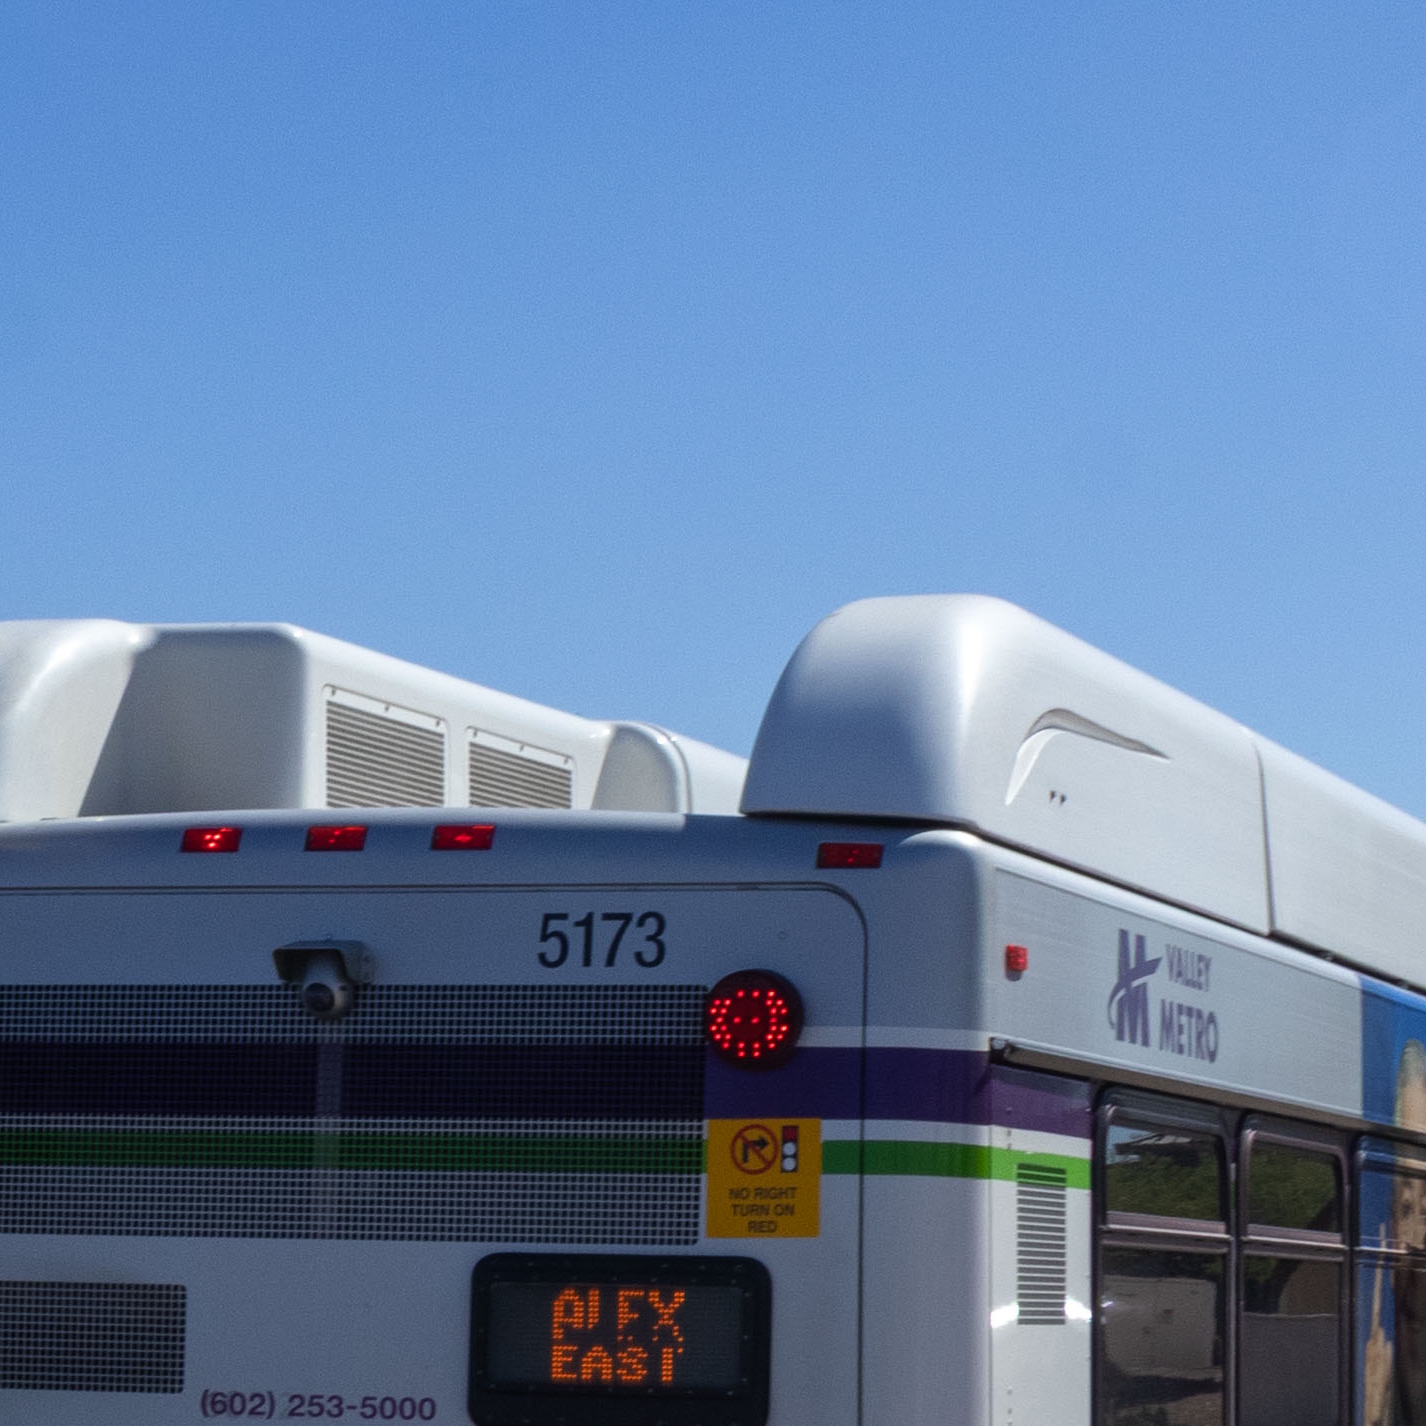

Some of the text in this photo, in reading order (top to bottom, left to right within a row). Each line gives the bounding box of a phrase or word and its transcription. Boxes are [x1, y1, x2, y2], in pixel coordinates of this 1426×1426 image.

[537, 911, 667, 969] 5173
[1165, 943, 1214, 993] VALLEY
[1159, 998, 1219, 1064] METRO
[728, 1186, 798, 1199] NO RIGHT
[731, 1204, 795, 1216] TURN ON
[748, 1220, 778, 1233] RED
[200, 1388, 436, 1421] (602) 253-5000
